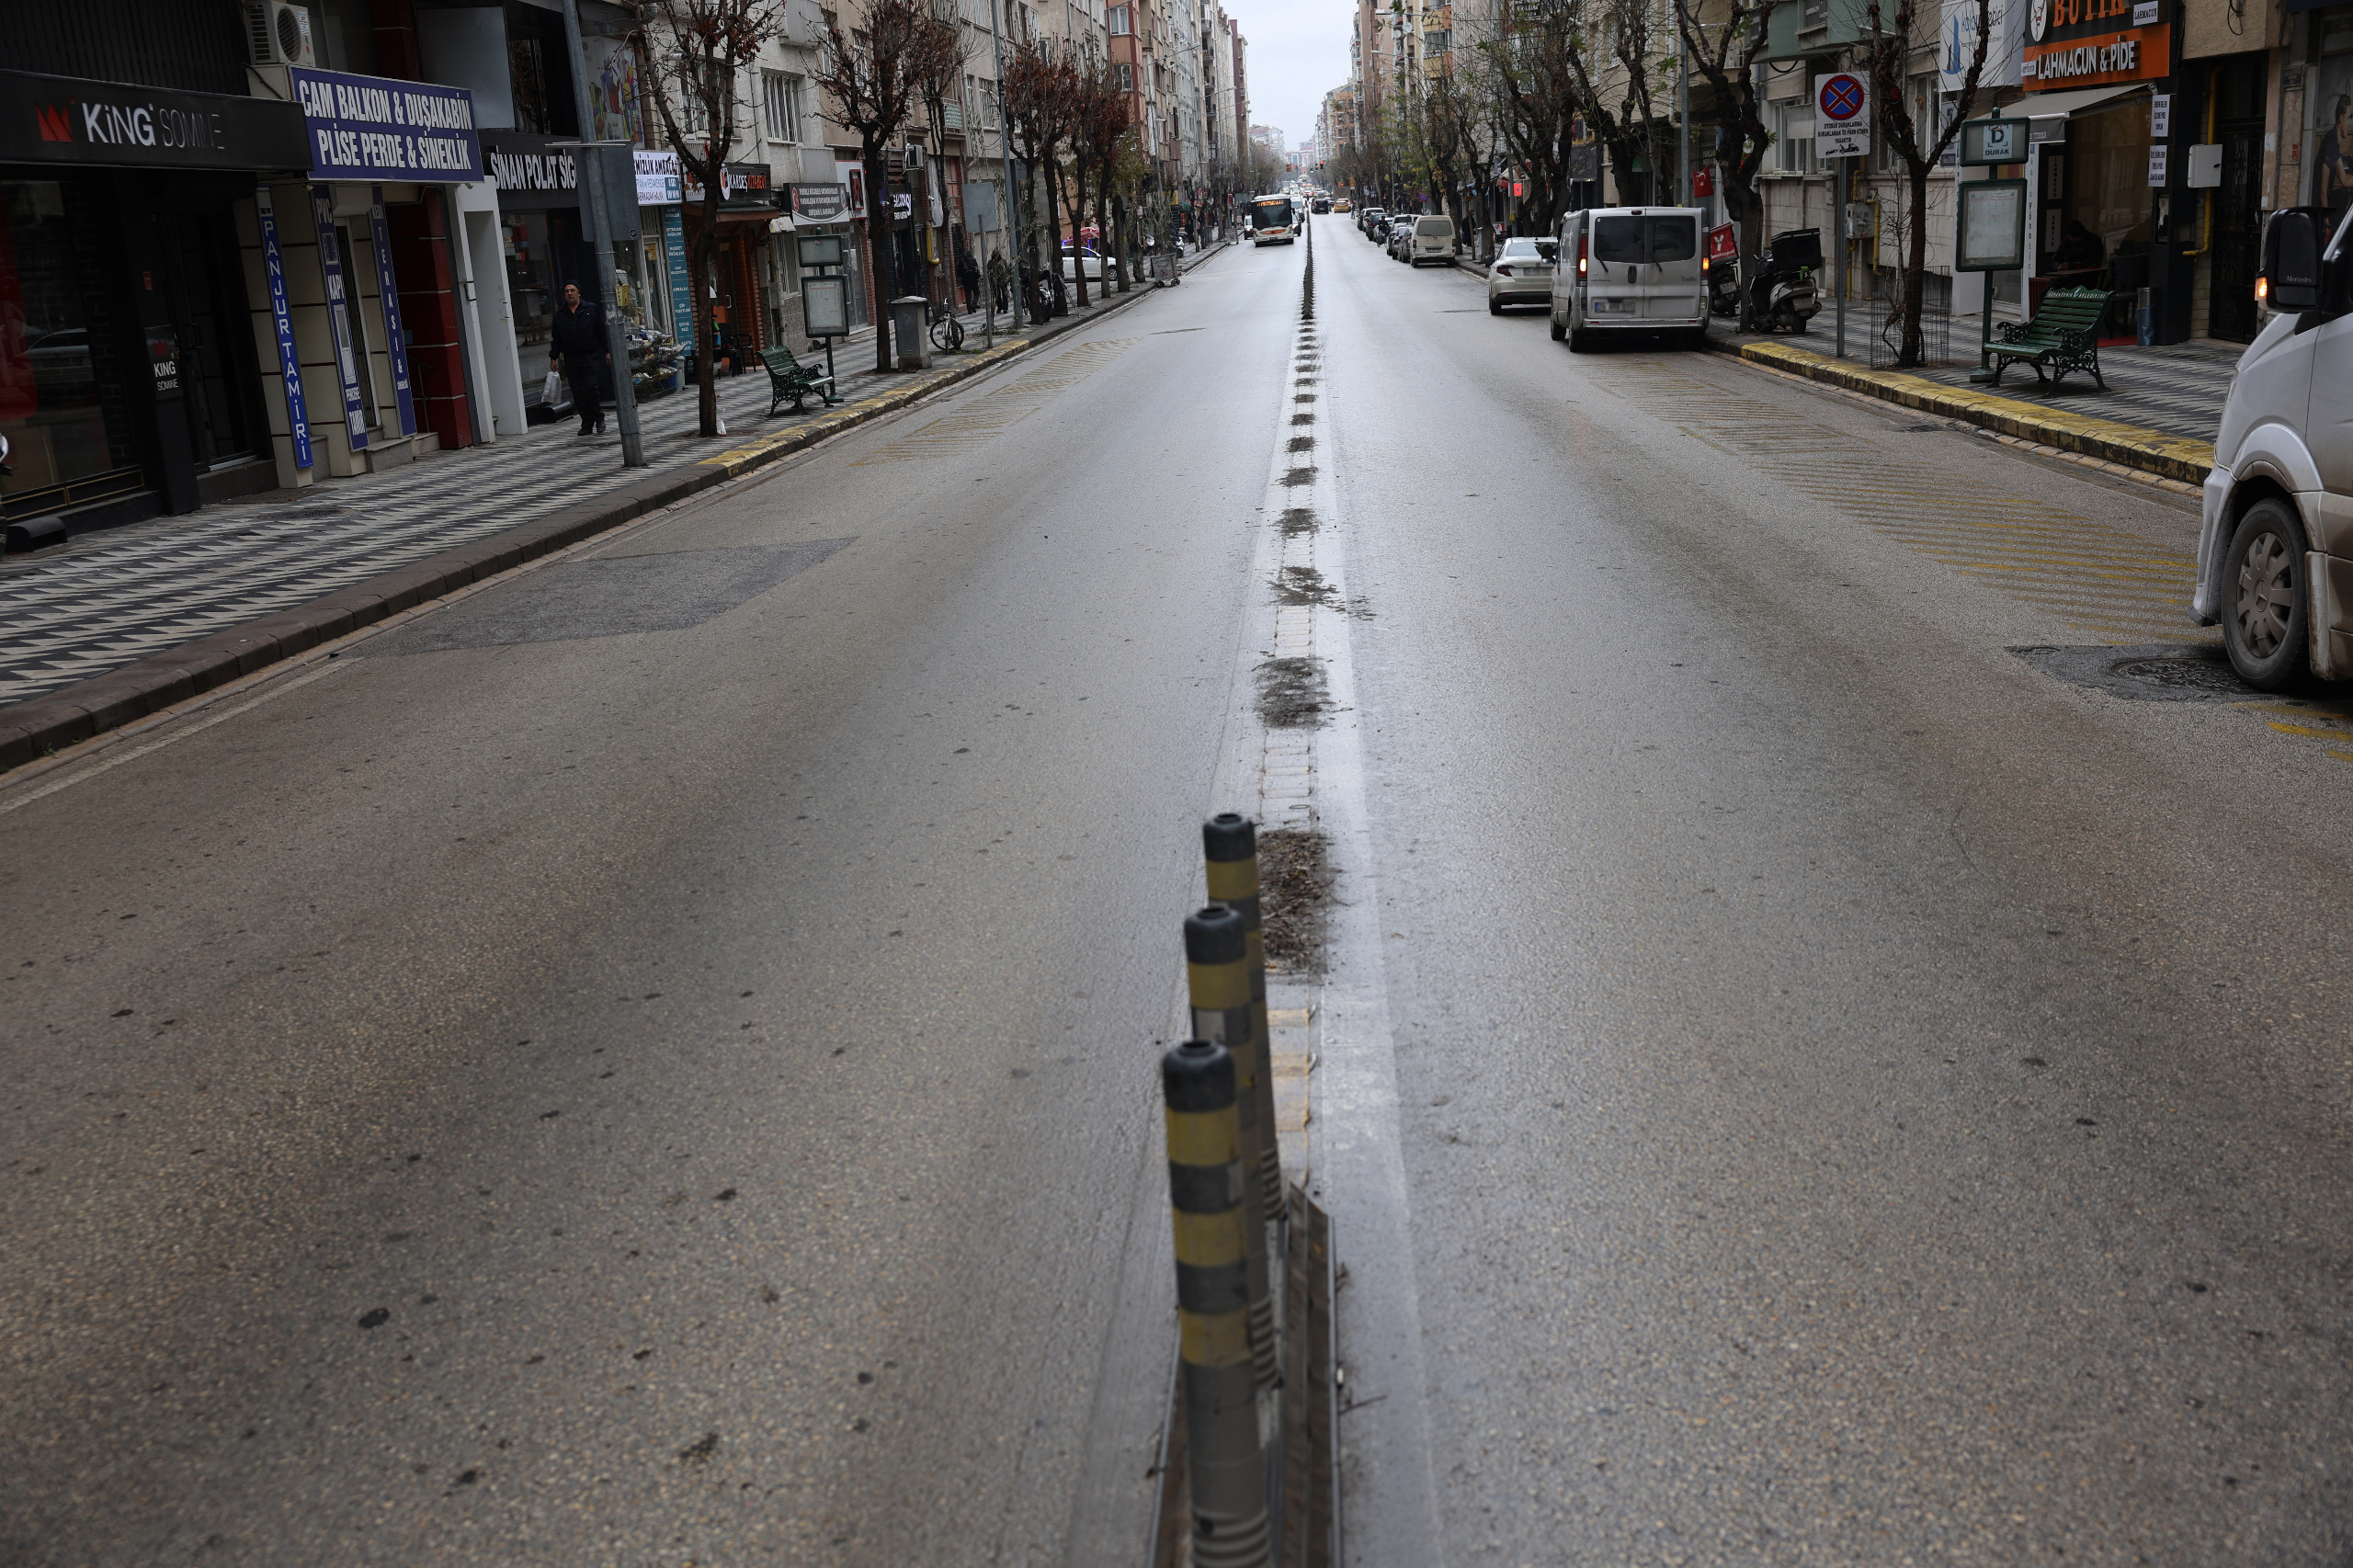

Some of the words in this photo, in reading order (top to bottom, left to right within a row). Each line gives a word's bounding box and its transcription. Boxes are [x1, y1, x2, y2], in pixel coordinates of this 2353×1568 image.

[2134, 7, 2157, 20] LAHMACUN
[2038, 46, 2097, 80] LAHMACUN
[2100, 47, 2109, 73] &
[2110, 35, 2135, 72] PİDE
[299, 79, 336, 119] CAM
[335, 84, 392, 124] BALKON
[392, 90, 405, 125] &
[404, 92, 472, 131] DUŞAKABİN
[316, 122, 361, 165] PLİSE
[360, 131, 406, 168] PERDE
[405, 135, 417, 168] &
[417, 130, 472, 170] SİNEKLİK
[1984, 148, 2009, 156] DURAK
[490, 144, 527, 190] SİNAN
[525, 154, 559, 189] POLAT
[558, 148, 578, 189] SİG
[634, 153, 654, 175] MİZLİK
[315, 198, 332, 224] PVC
[264, 220, 290, 335] PANJUR
[326, 275, 345, 301] KAPI
[153, 360, 176, 377] KING
[397, 358, 404, 374] &
[281, 342, 308, 460] TAMİRİ
